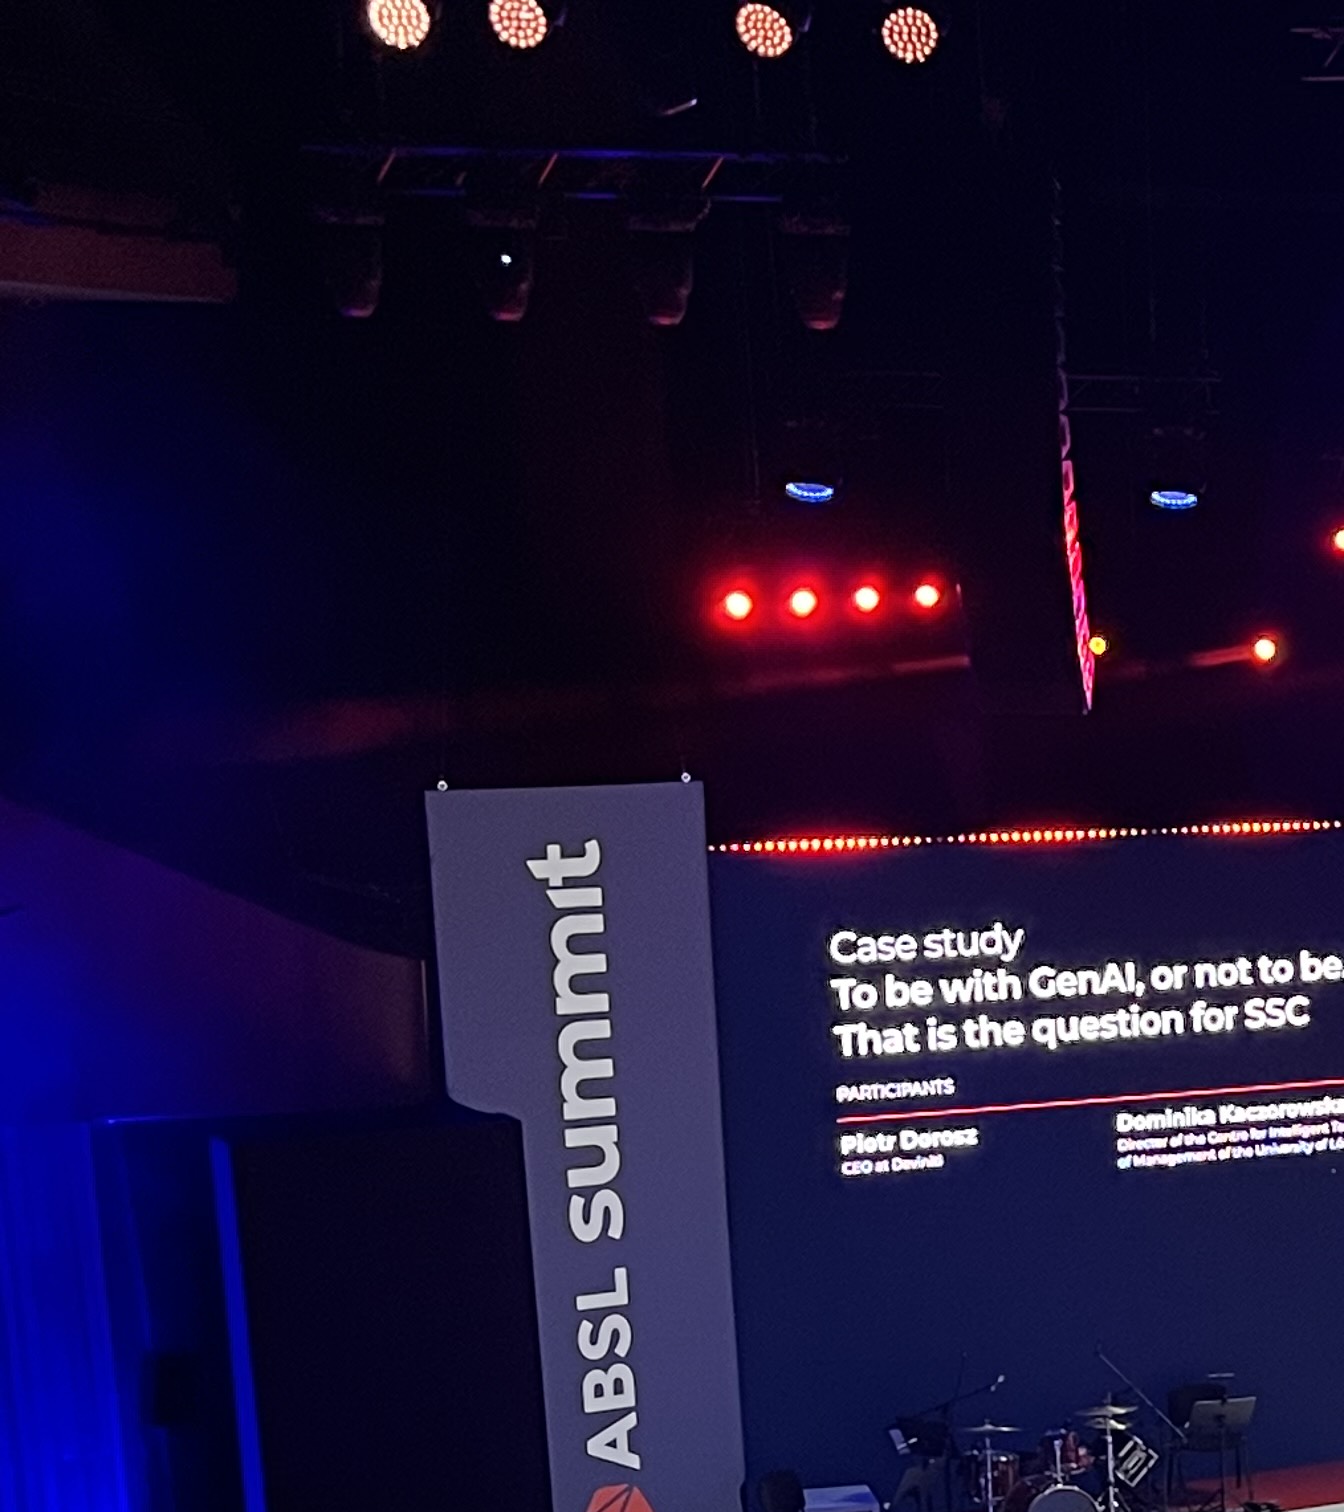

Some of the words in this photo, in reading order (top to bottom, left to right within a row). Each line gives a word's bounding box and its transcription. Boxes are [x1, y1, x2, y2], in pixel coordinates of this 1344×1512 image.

[830, 931, 918, 963] Case
[923, 922, 1024, 962] study
[830, 977, 878, 1011] To
[885, 974, 933, 1007] be
[938, 968, 1022, 1003] with
[1029, 961, 1145, 998] GenAI,
[1151, 965, 1188, 991] or
[1195, 957, 1254, 987] not
[1258, 955, 1294, 984] to
[832, 1022, 921, 1057] That
[926, 1016, 957, 1051] is
[963, 1015, 1025, 1048] the
[1032, 1003, 1185, 1050] question
[1190, 1000, 1238, 1033] for
[1244, 995, 1311, 1029] SSC
[526, 839, 625, 1242] summit
[836, 1078, 955, 1102] PARTICIPANTS
[1117, 1107, 1216, 1132] Dominika
[841, 1133, 897, 1155] Piotr
[899, 1128, 979, 1150] Dorosz
[1170, 1133, 1183, 1147] of
[1184, 1133, 1206, 1146] the
[841, 1160, 873, 1175] CEO
[875, 1160, 889, 1172] at
[1117, 1155, 1132, 1169] of
[1218, 1146, 1231, 1160] of
[1232, 1146, 1253, 1158] the
[576, 1267, 641, 1471] ABSL
